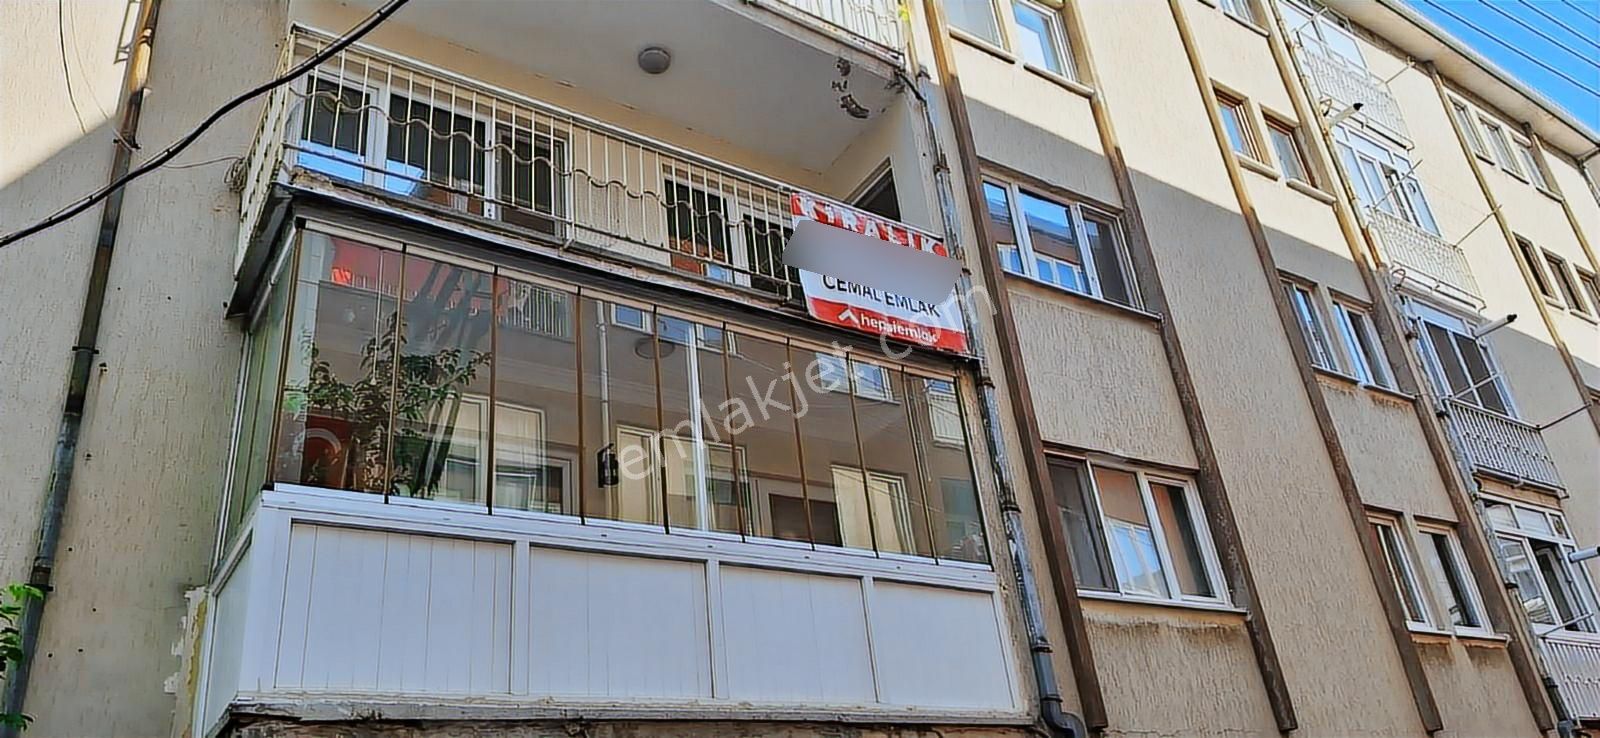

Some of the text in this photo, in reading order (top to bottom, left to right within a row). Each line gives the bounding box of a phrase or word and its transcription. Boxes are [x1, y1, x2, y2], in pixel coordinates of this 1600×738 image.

[822, 274, 940, 318] CEMAL EMLAK
[860, 312, 938, 344] hepsiemlak
